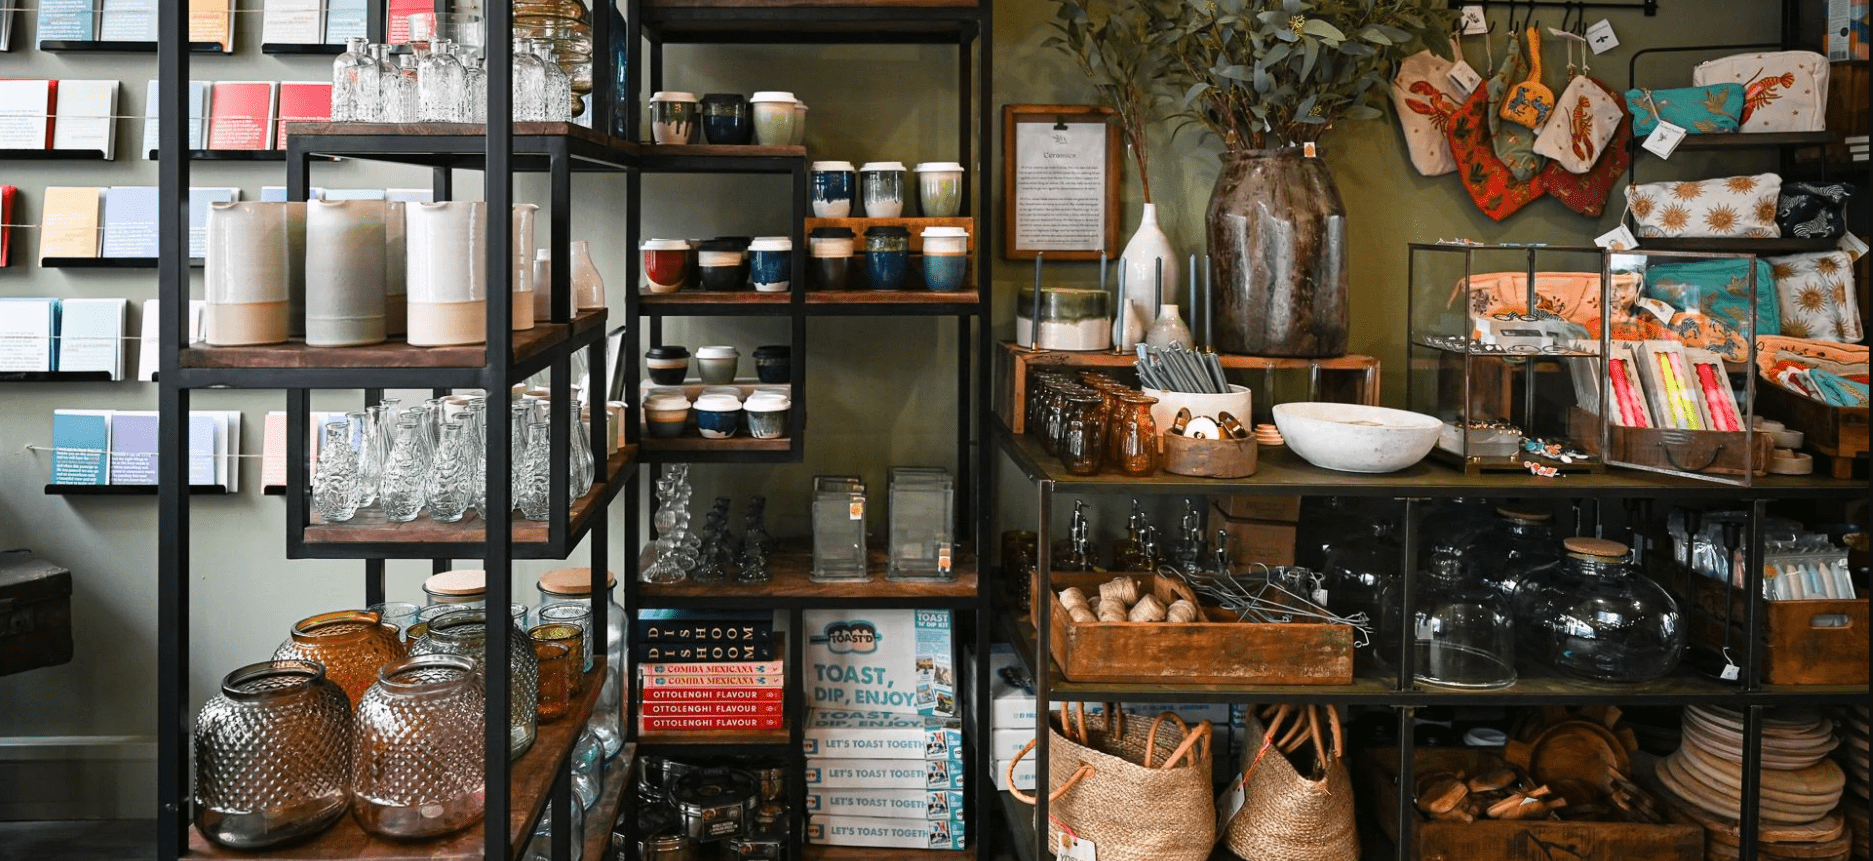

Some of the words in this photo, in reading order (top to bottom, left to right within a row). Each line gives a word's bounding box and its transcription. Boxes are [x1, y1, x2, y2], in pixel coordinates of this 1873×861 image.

[917, 613, 949, 622] TOAST
[648, 627, 754, 640] DISHOOM
[830, 633, 874, 644] TOAST'D
[649, 645, 755, 659] DISHOOM
[667, 665, 704, 673] COMIDA
[706, 665, 754, 673] MEXICANA
[668, 677, 705, 685] COMIDA
[707, 676, 755, 685] MEXICANA
[814, 663, 894, 689] TOAST,
[653, 691, 713, 699] OTTOLENGHI
[716, 691, 758, 699] FLAVOUR
[814, 687, 850, 706] DIP,
[855, 689, 919, 707] ENJOY.
[652, 705, 712, 713] OTTOLENGHI
[716, 705, 757, 713] FLAVOUR
[818, 711, 899, 721] TOAST,
[653, 719, 713, 727] OTTOLENGHI
[716, 719, 758, 727] FLAVOUR
[815, 720, 852, 728] DIP,
[858, 720, 924, 728] ENJOY.
[825, 739, 850, 748] LET'S
[852, 739, 884, 748] TOAST
[829, 769, 853, 778] LET'S
[856, 769, 887, 778] TOAST
[830, 796, 854, 806] LET'S
[857, 797, 888, 807] TOAST
[831, 826, 855, 836] LET'S
[857, 827, 889, 837] TOAST
